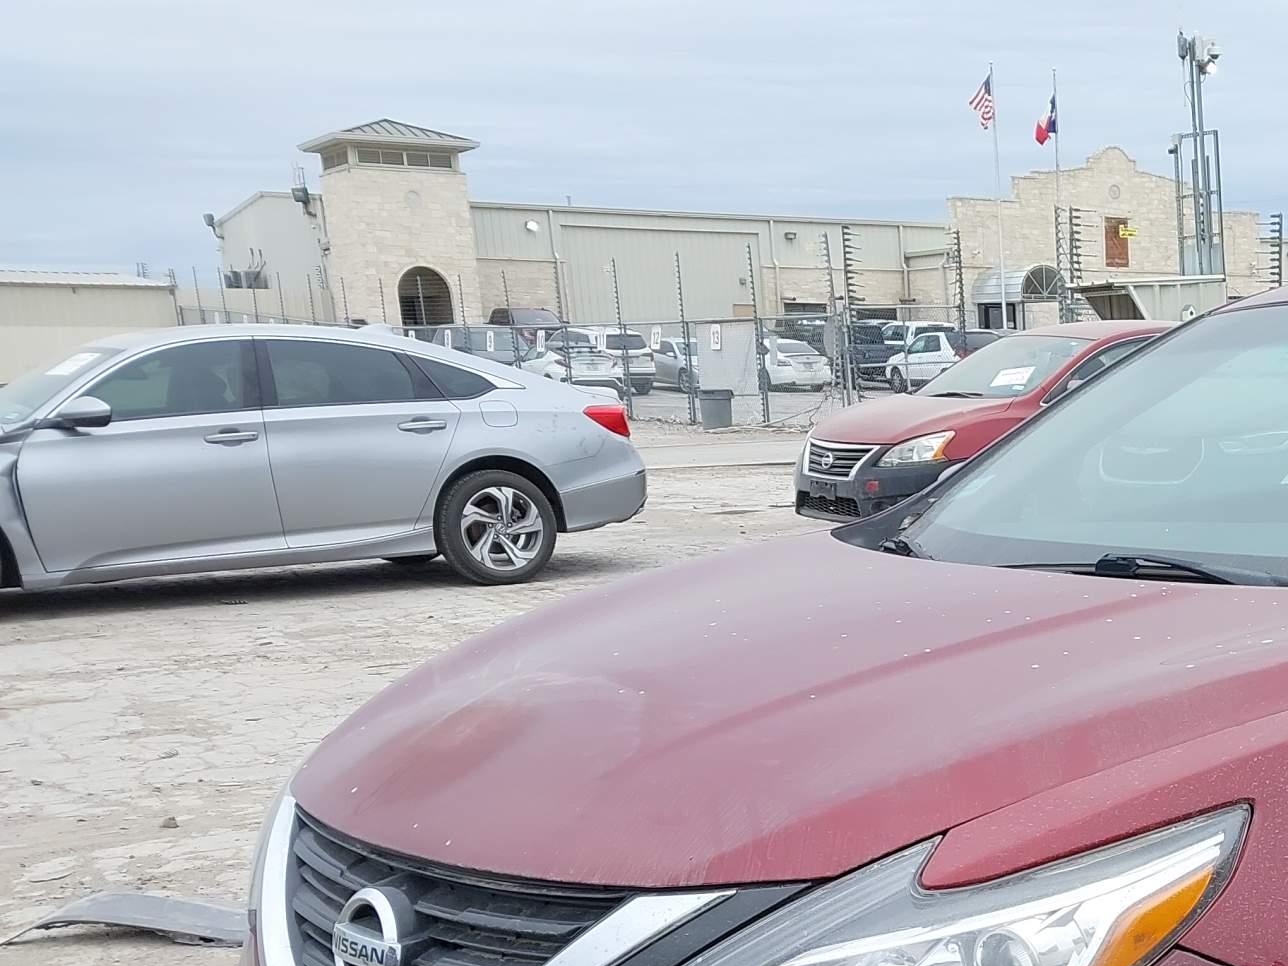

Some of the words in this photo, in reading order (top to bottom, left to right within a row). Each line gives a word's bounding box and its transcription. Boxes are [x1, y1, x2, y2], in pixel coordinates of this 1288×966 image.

[652, 331, 660, 345] 12
[711, 330, 720, 345] 13
[332, 930, 385, 966] NISSAN
